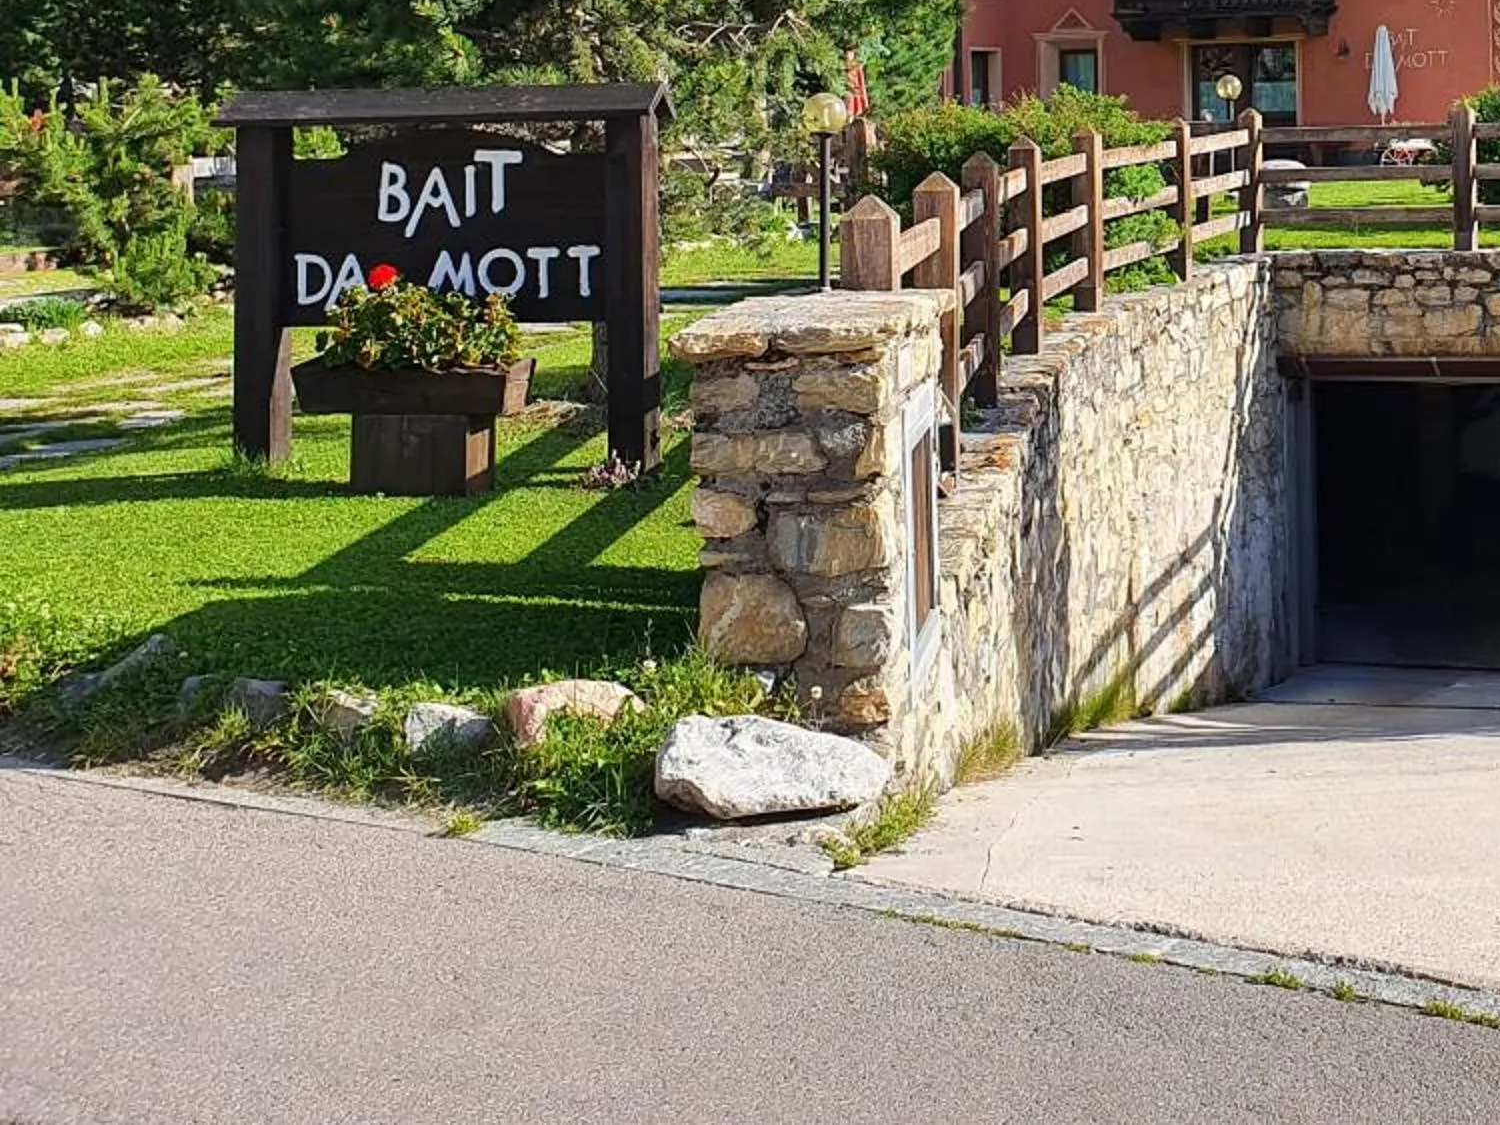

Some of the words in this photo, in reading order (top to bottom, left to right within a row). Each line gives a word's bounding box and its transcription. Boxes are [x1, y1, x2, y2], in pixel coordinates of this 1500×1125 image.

[1395, 50, 1448, 71] MOTT
[377, 150, 523, 238] BAIT
[427, 245, 601, 298] MOTT
